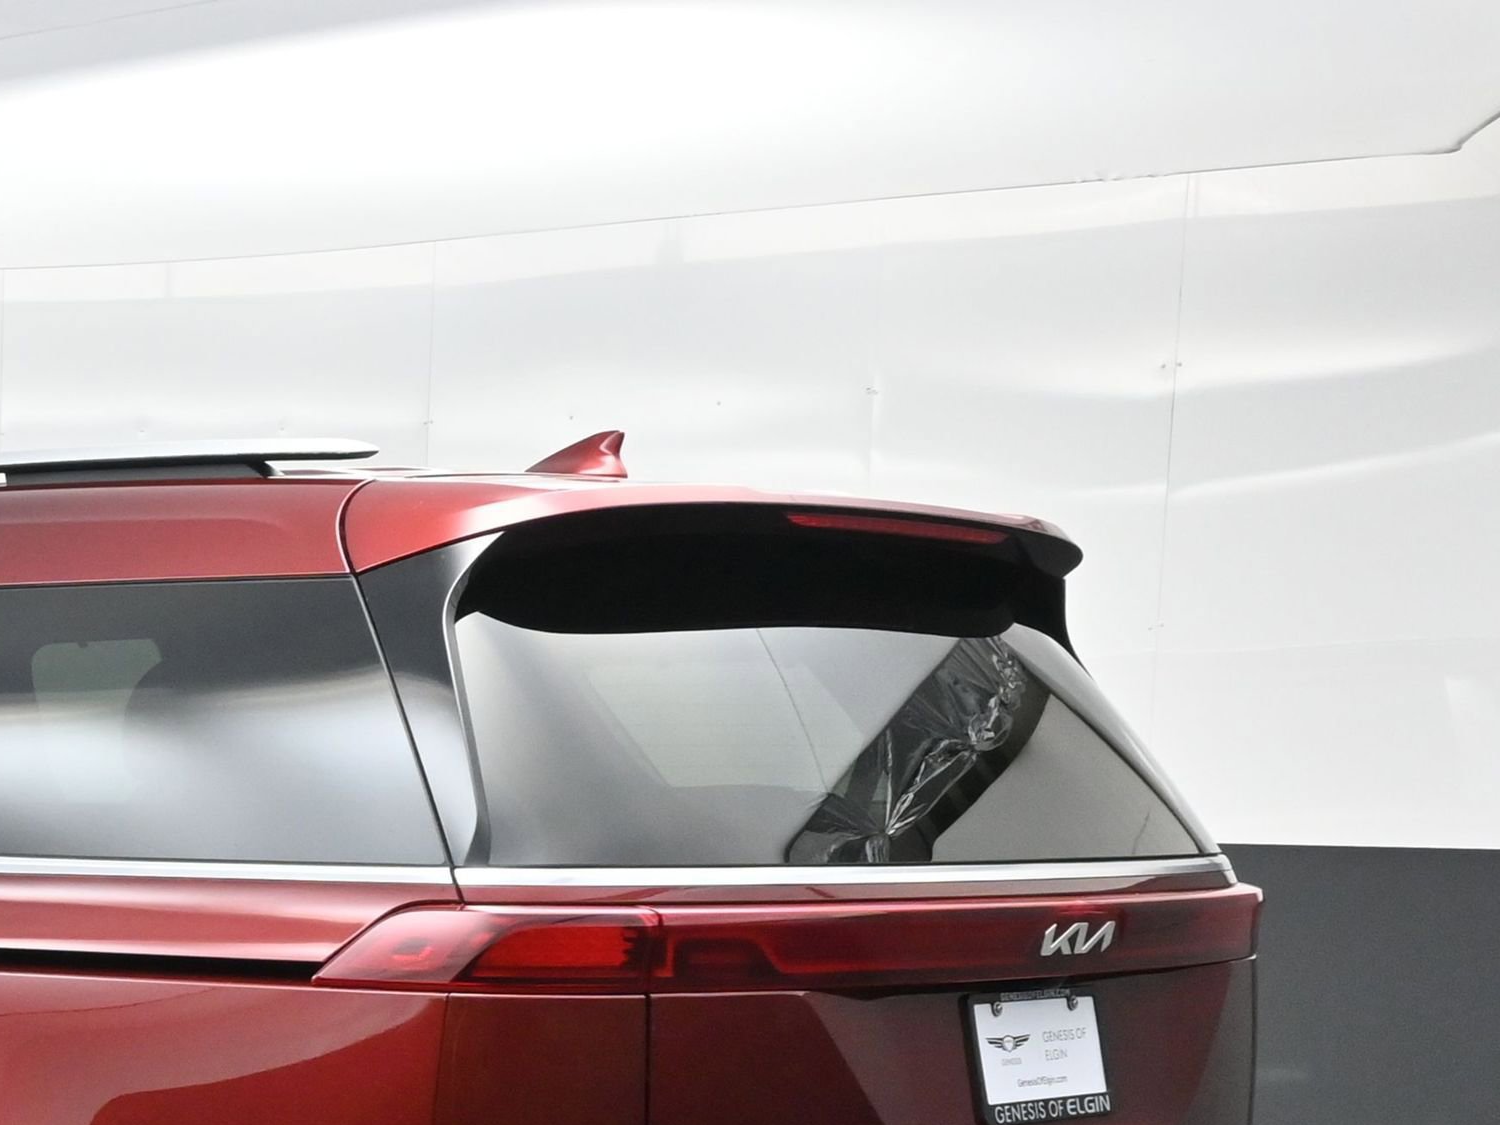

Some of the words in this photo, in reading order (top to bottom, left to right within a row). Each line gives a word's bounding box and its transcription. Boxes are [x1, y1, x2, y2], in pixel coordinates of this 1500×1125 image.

[1040, 920, 1116, 956] KIA
[1042, 1029, 1074, 1043] GENESIS
[1077, 1027, 1087, 1040] OF
[1045, 1049, 1068, 1061] ELGIN
[995, 1102, 1047, 1124] GENESIS
[1049, 1101, 1065, 1118] OF
[1067, 1095, 1111, 1116] ELGIN
